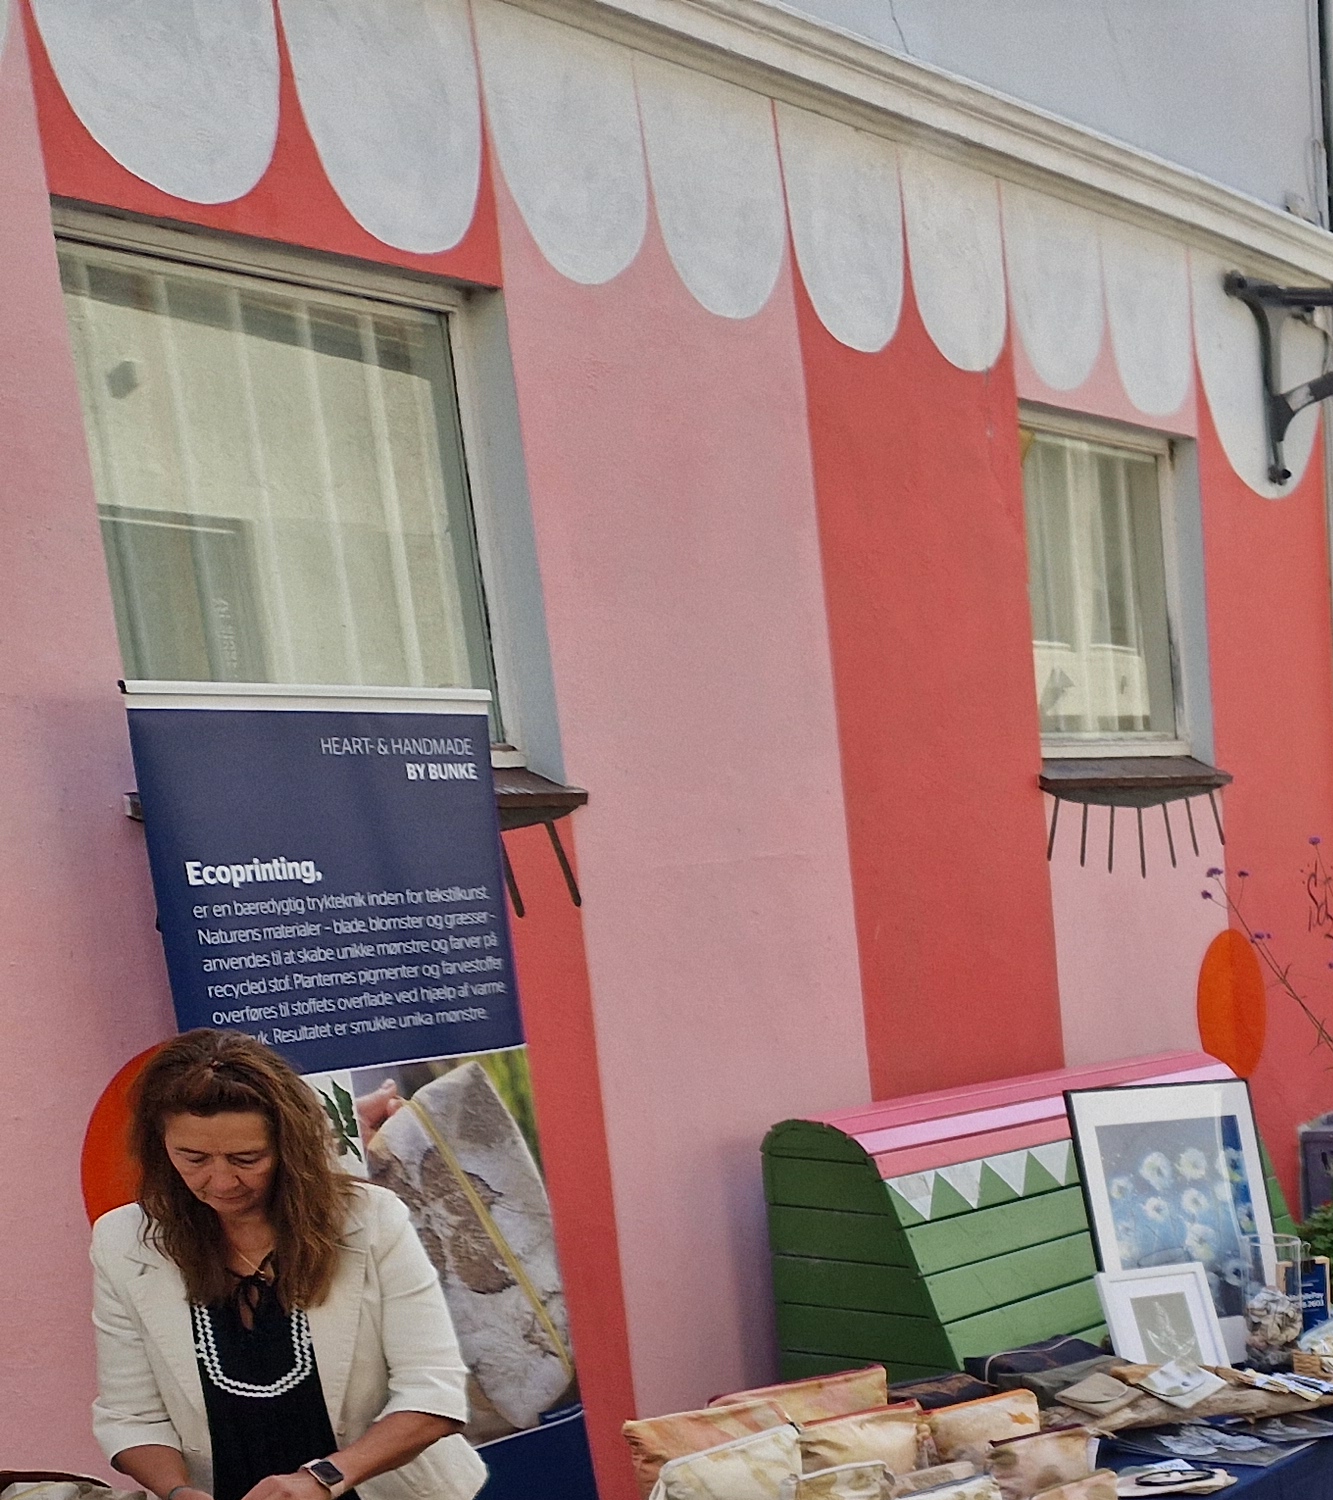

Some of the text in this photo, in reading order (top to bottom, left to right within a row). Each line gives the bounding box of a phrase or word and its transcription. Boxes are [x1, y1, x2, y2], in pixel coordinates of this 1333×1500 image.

[377, 738, 389, 755] &
[391, 738, 474, 756] HANDMADE
[406, 762, 478, 780] BY BUNKE
[185, 856, 323, 889] Ecoprinting,
[193, 905, 209, 919] er
[212, 903, 232, 918] en
[233, 898, 305, 916] bæredygtig
[306, 891, 367, 912] trykteknik
[367, 890, 404, 907] inden
[405, 888, 424, 904] for
[197, 927, 262, 945] Naturens
[263, 921, 321, 940] materialer
[368, 914, 424, 931] blomster
[426, 917, 443, 930] og
[203, 931, 498, 973] anvendes til at skabe unikke mønstre og farver på
[207, 977, 266, 999] recycled
[293, 971, 357, 990] Planternes
[358, 964, 420, 985] pigmenter
[422, 965, 440, 979] og
[441, 956, 502, 976] farvestoffer
[212, 1004, 277, 1025] overføres
[278, 1001, 290, 1018] til
[291, 996, 335, 1015] stoffets
[337, 990, 393, 1010] overflade
[395, 987, 418, 1004] ved
[420, 985, 456, 1004] hjælp
[457, 982, 468, 999] af
[273, 1022, 333, 1045] Resultatet
[334, 1022, 348, 1037] er
[398, 1011, 434, 1029] unika
